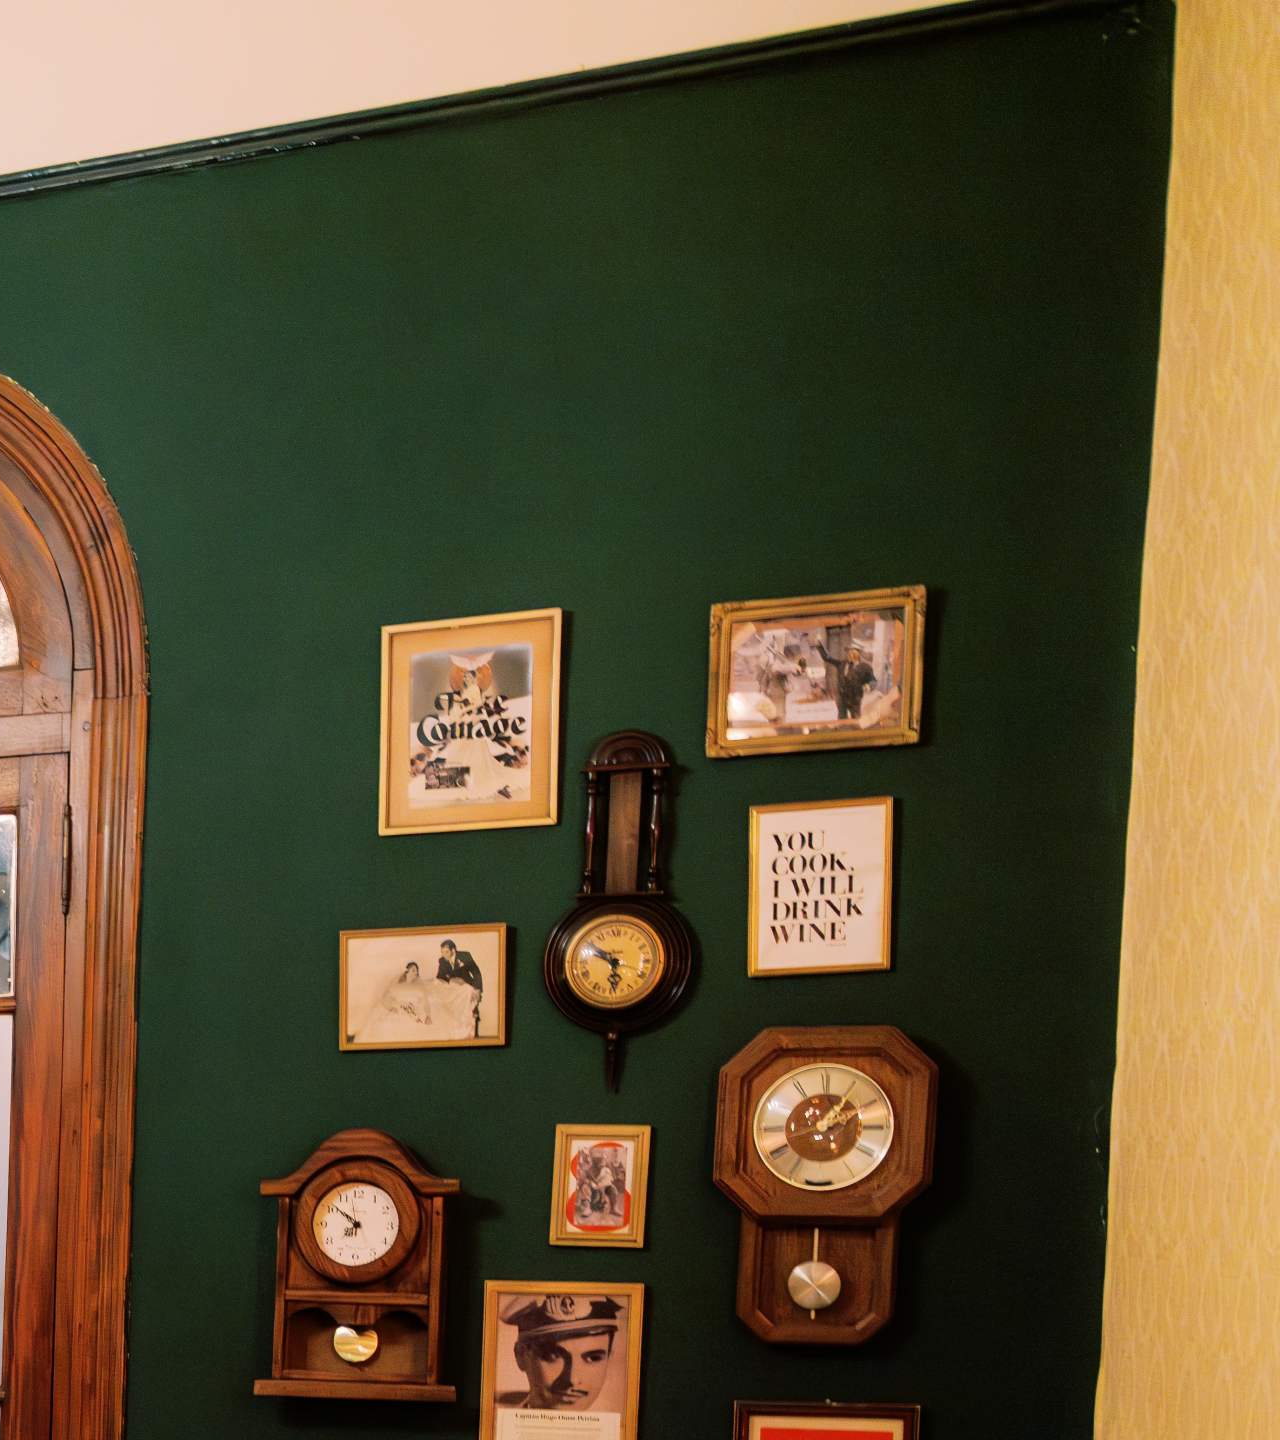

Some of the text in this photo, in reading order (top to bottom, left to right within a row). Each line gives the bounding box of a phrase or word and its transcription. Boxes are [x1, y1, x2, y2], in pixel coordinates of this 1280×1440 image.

[416, 714, 527, 748] Courage
[772, 830, 826, 852] YOU
[773, 874, 865, 899] I WILL
[771, 897, 864, 921] DRINK
[770, 921, 847, 945] WINE
